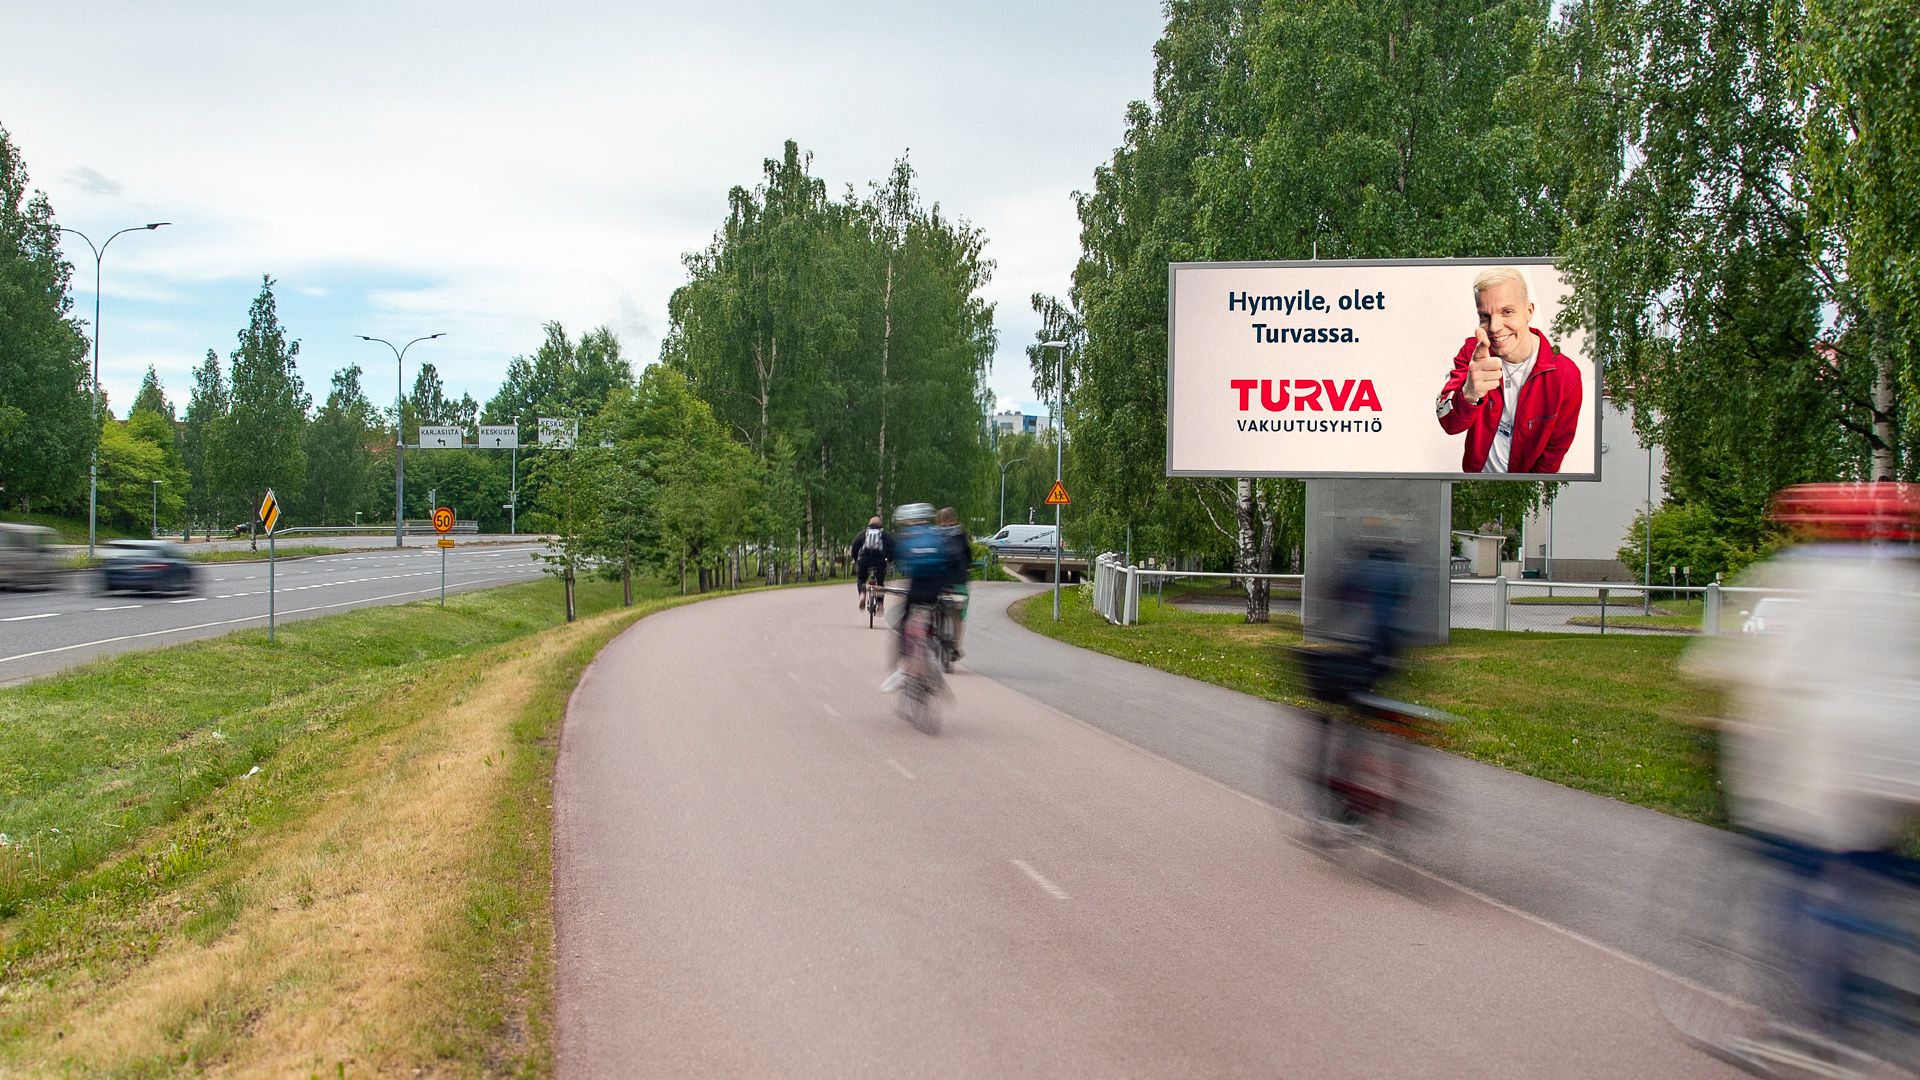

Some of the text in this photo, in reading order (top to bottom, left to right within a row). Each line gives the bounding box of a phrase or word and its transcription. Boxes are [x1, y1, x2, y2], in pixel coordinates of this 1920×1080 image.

[1228, 289, 1385, 316] Hymyile, olet
[1252, 323, 1360, 344] Turvassa.
[1230, 379, 1383, 412] TURVA
[1237, 418, 1383, 433] VAKUUTUSYHTIÖ
[436, 515, 450, 528] 50
